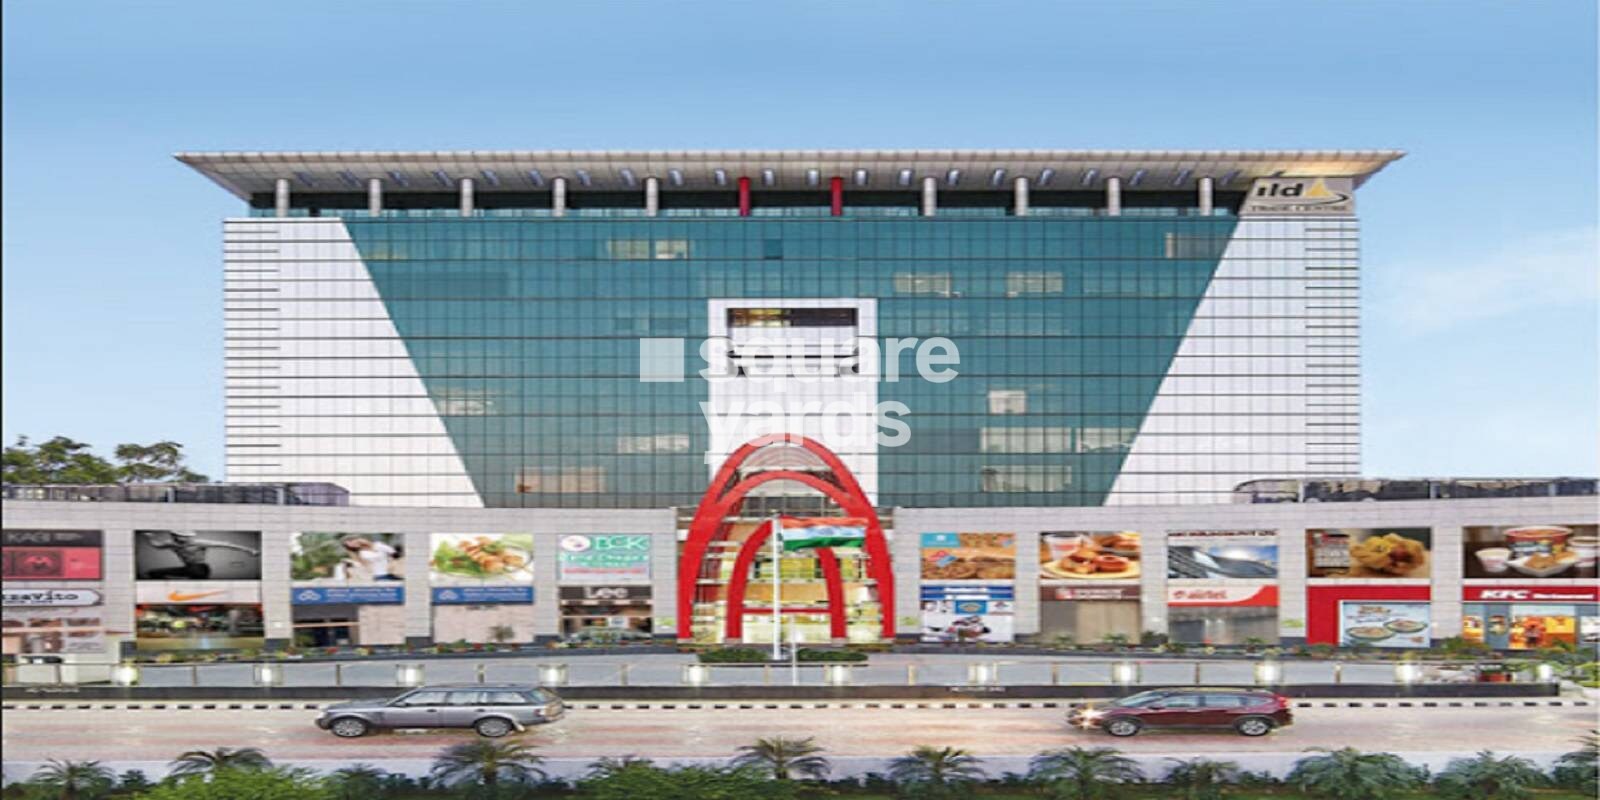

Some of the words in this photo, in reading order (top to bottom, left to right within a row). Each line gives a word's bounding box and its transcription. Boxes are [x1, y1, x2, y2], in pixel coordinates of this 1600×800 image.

[1257, 183, 1304, 196] ild
[584, 586, 628, 599] Lee
[1189, 590, 1227, 599] airtel
[1480, 589, 1530, 599] KFC
